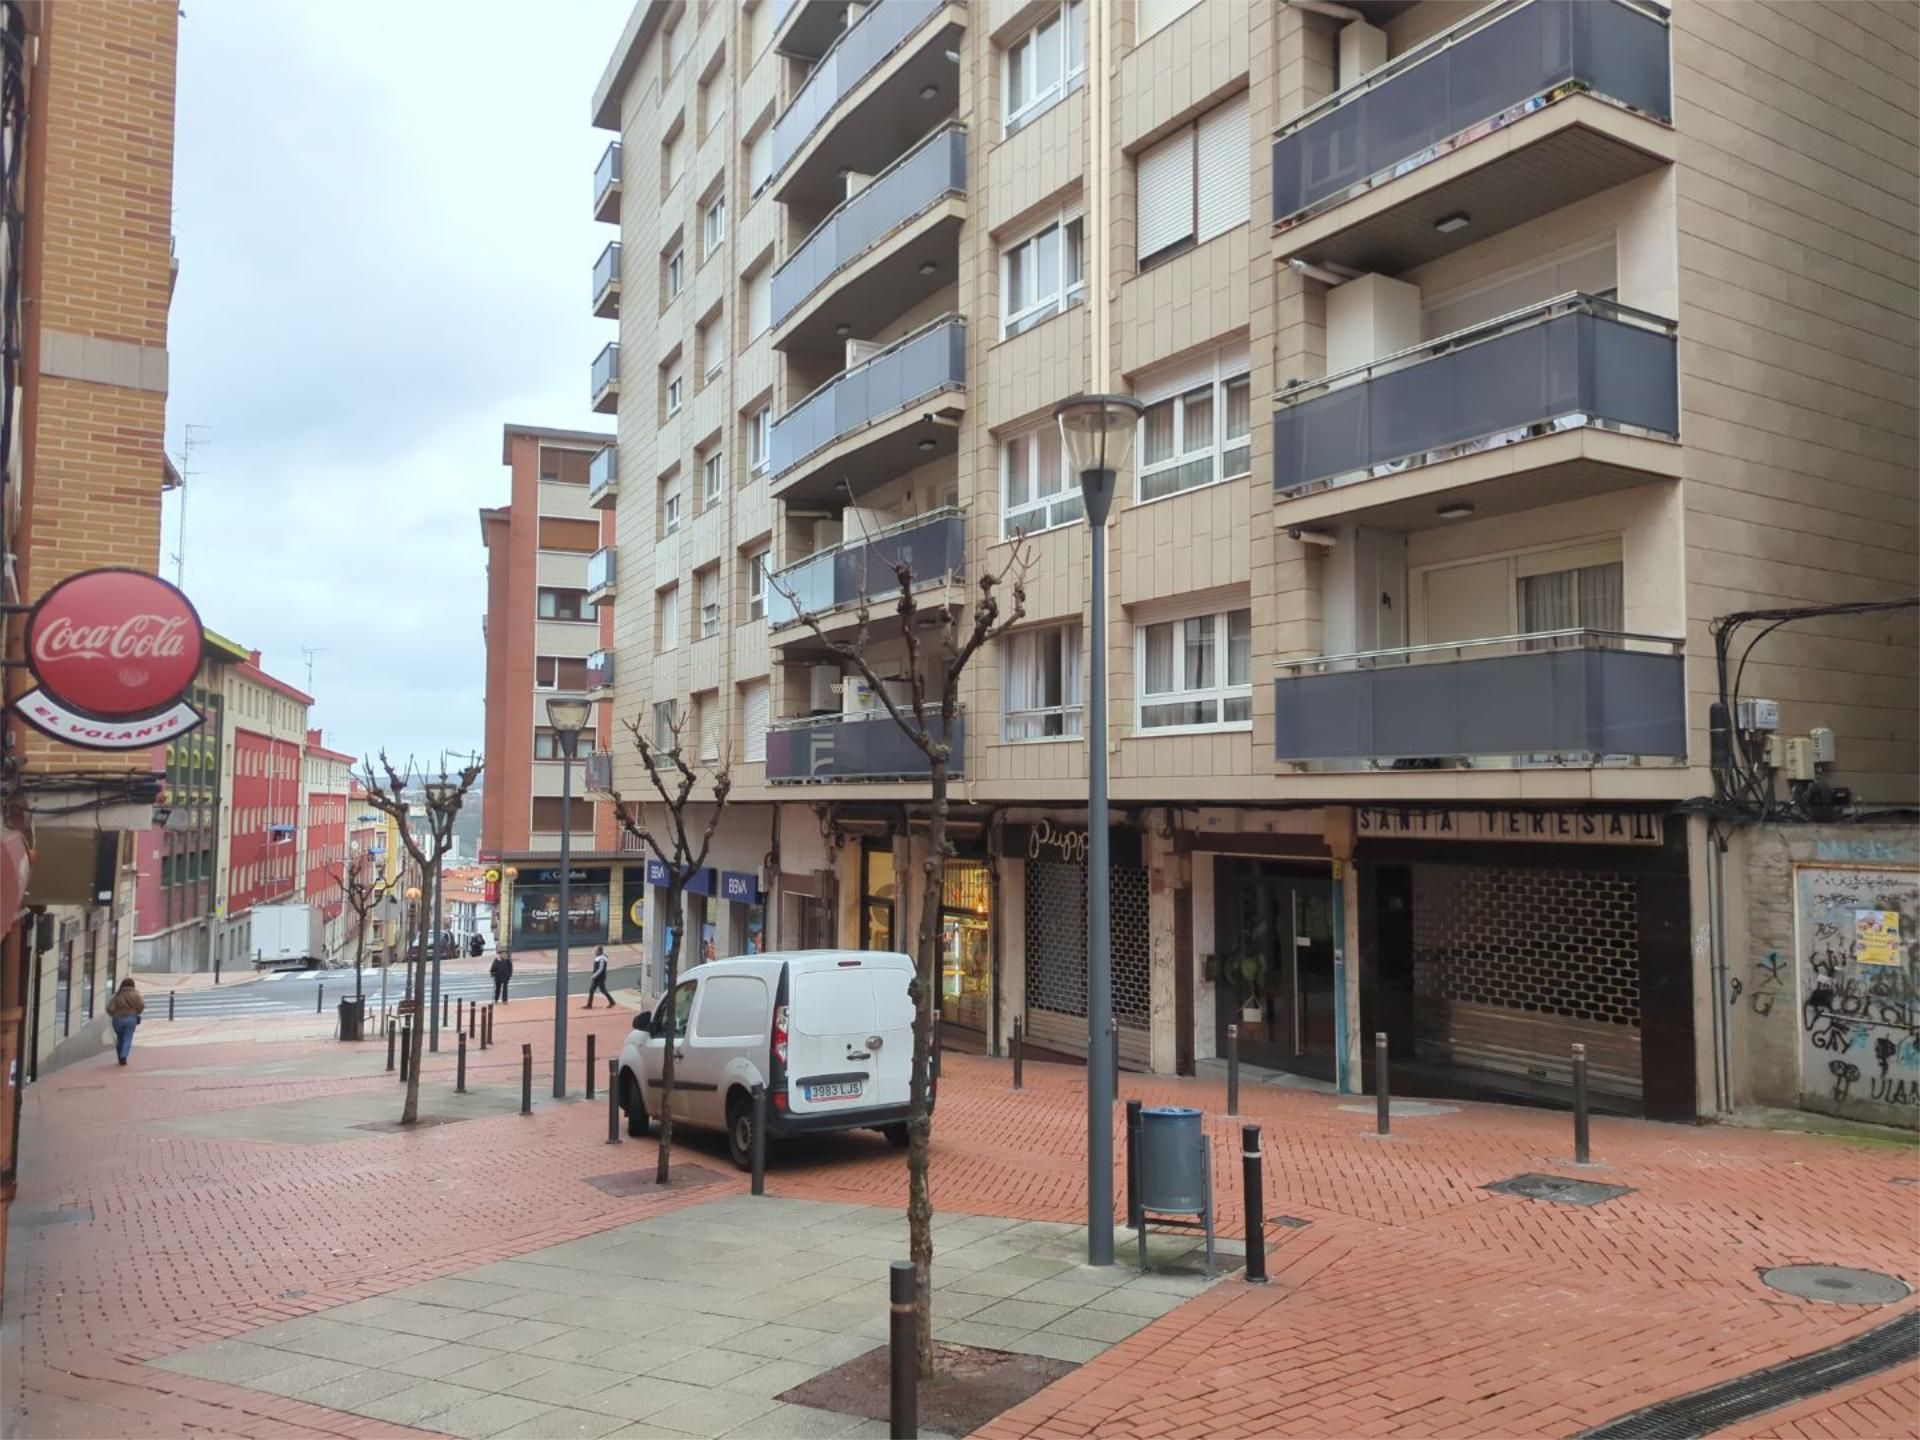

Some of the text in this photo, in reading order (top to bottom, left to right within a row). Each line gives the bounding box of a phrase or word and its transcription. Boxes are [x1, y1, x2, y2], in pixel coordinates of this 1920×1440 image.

[36, 614, 188, 662] Coca-Cola
[35, 706, 179, 740] EL VOLANTE
[1360, 808, 1452, 832] SANTA
[1487, 810, 1623, 835] TERESA
[1029, 817, 1088, 861] Pupp
[651, 865, 665, 880] BBVA
[728, 877, 748, 895] BBVA
[1811, 1030, 1854, 1055] GAY
[813, 1083, 860, 1097] 3983 LJS
